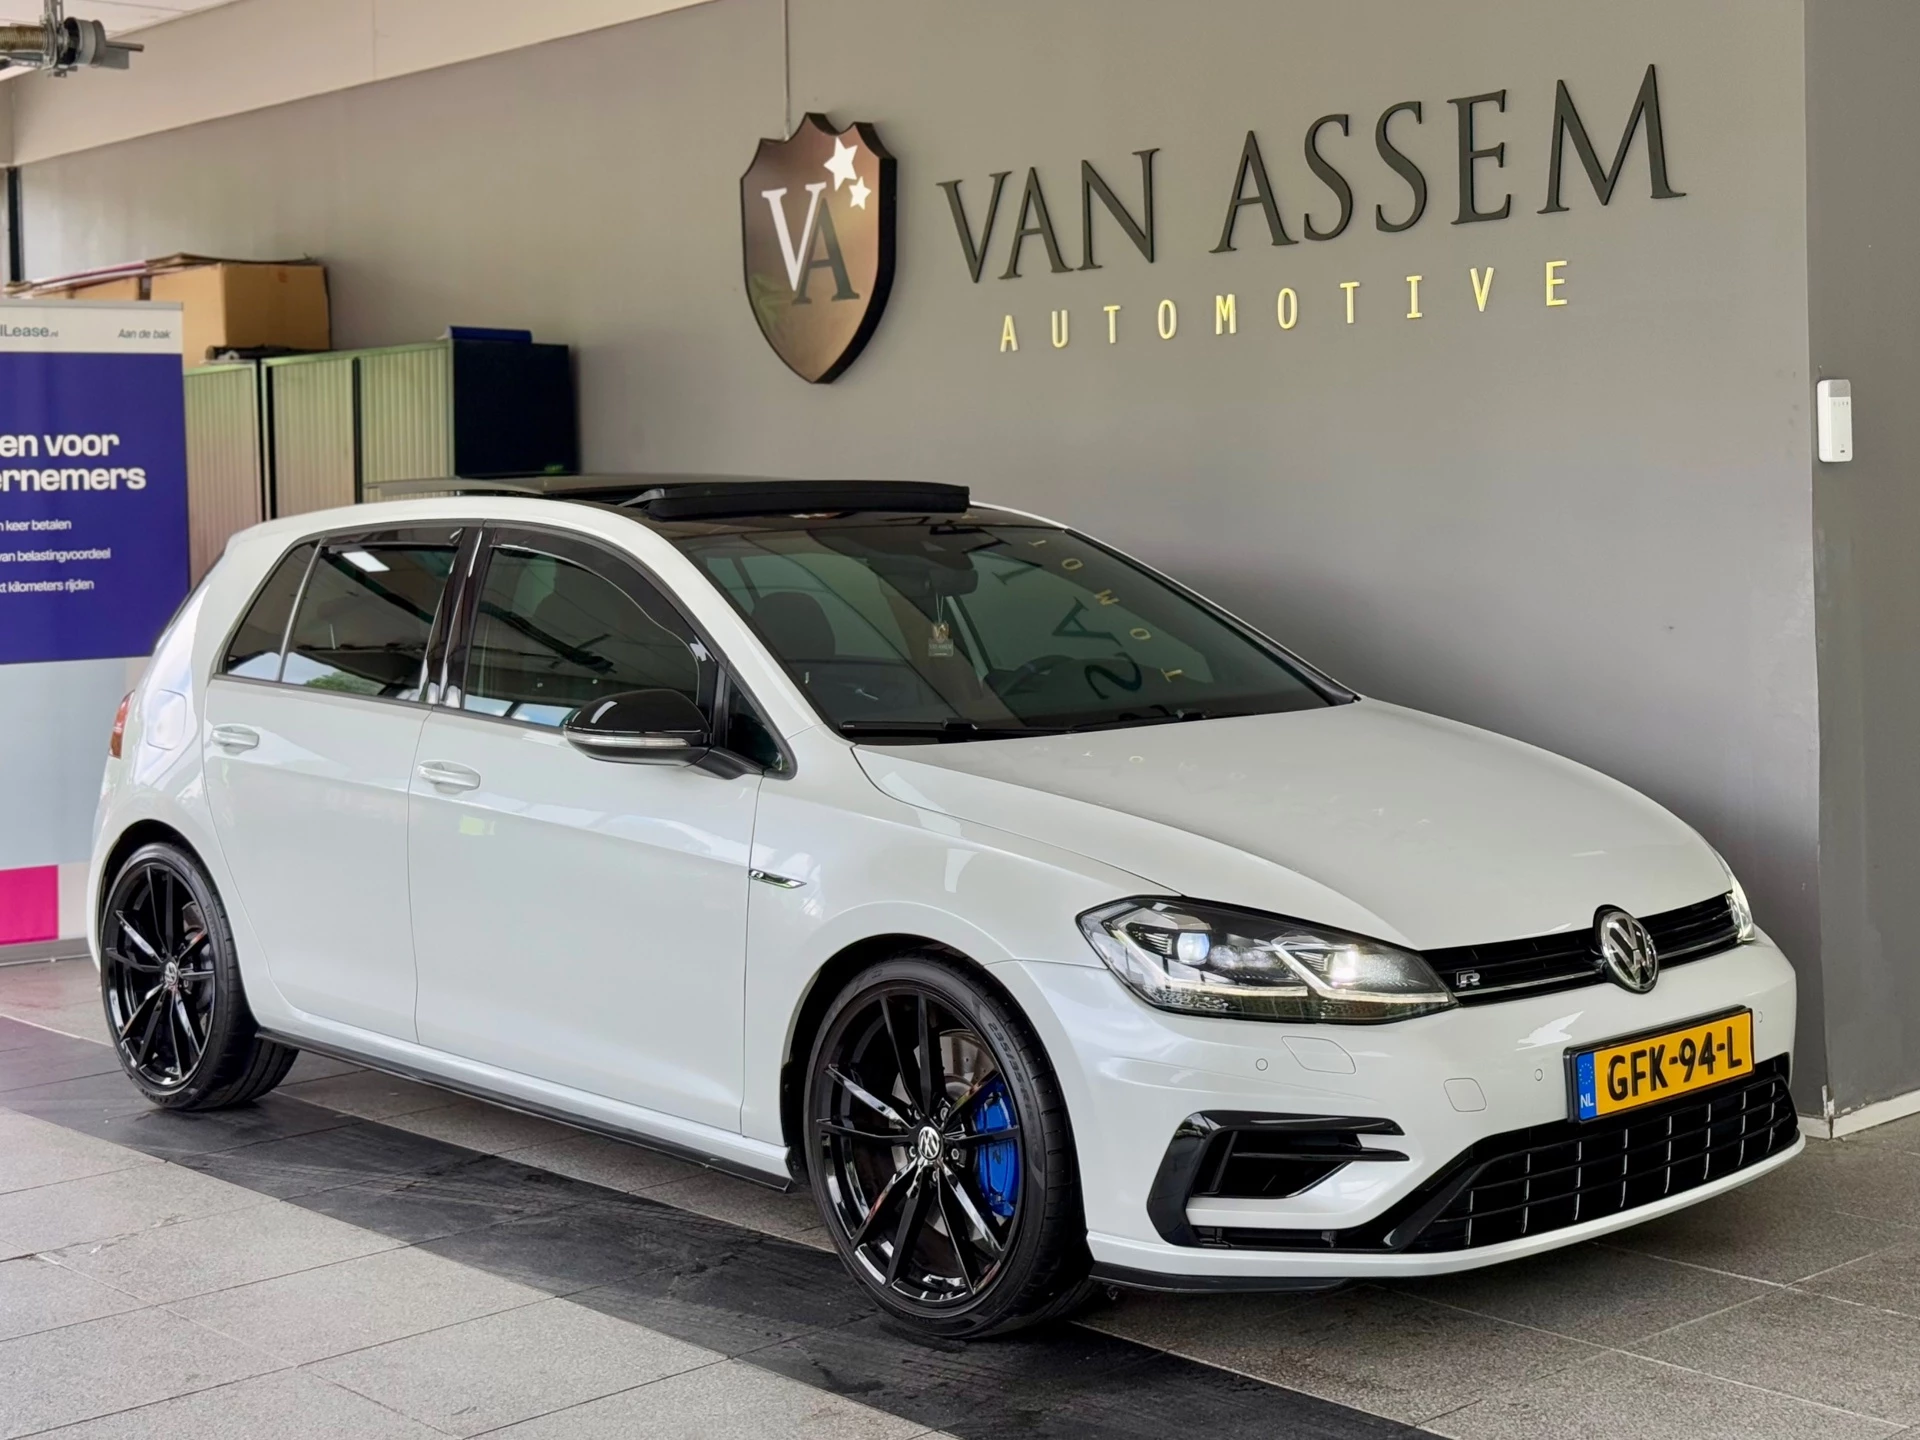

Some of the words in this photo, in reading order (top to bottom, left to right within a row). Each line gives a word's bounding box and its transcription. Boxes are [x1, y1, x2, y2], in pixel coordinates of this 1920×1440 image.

[935, 147, 1162, 284] VAN
[1208, 63, 1688, 254] ASSEM
[761, 181, 861, 306] VA
[999, 260, 1568, 353] AUTOMOTIVE
[117, 328, 137, 339] Aan
[138, 328, 151, 339] de
[152, 328, 172, 339] bak
[44, 433, 120, 457] voor
[0, 467, 147, 492] rnemers
[6, 519, 30, 531] keer
[31, 518, 72, 531] betalen
[17, 547, 111, 564] belastingvoordeel
[8, 580, 63, 593] kilometers
[65, 578, 94, 593] rijden
[1607, 1026, 1743, 1101] GFK-94-L
[1580, 1092, 1595, 1109] NL
